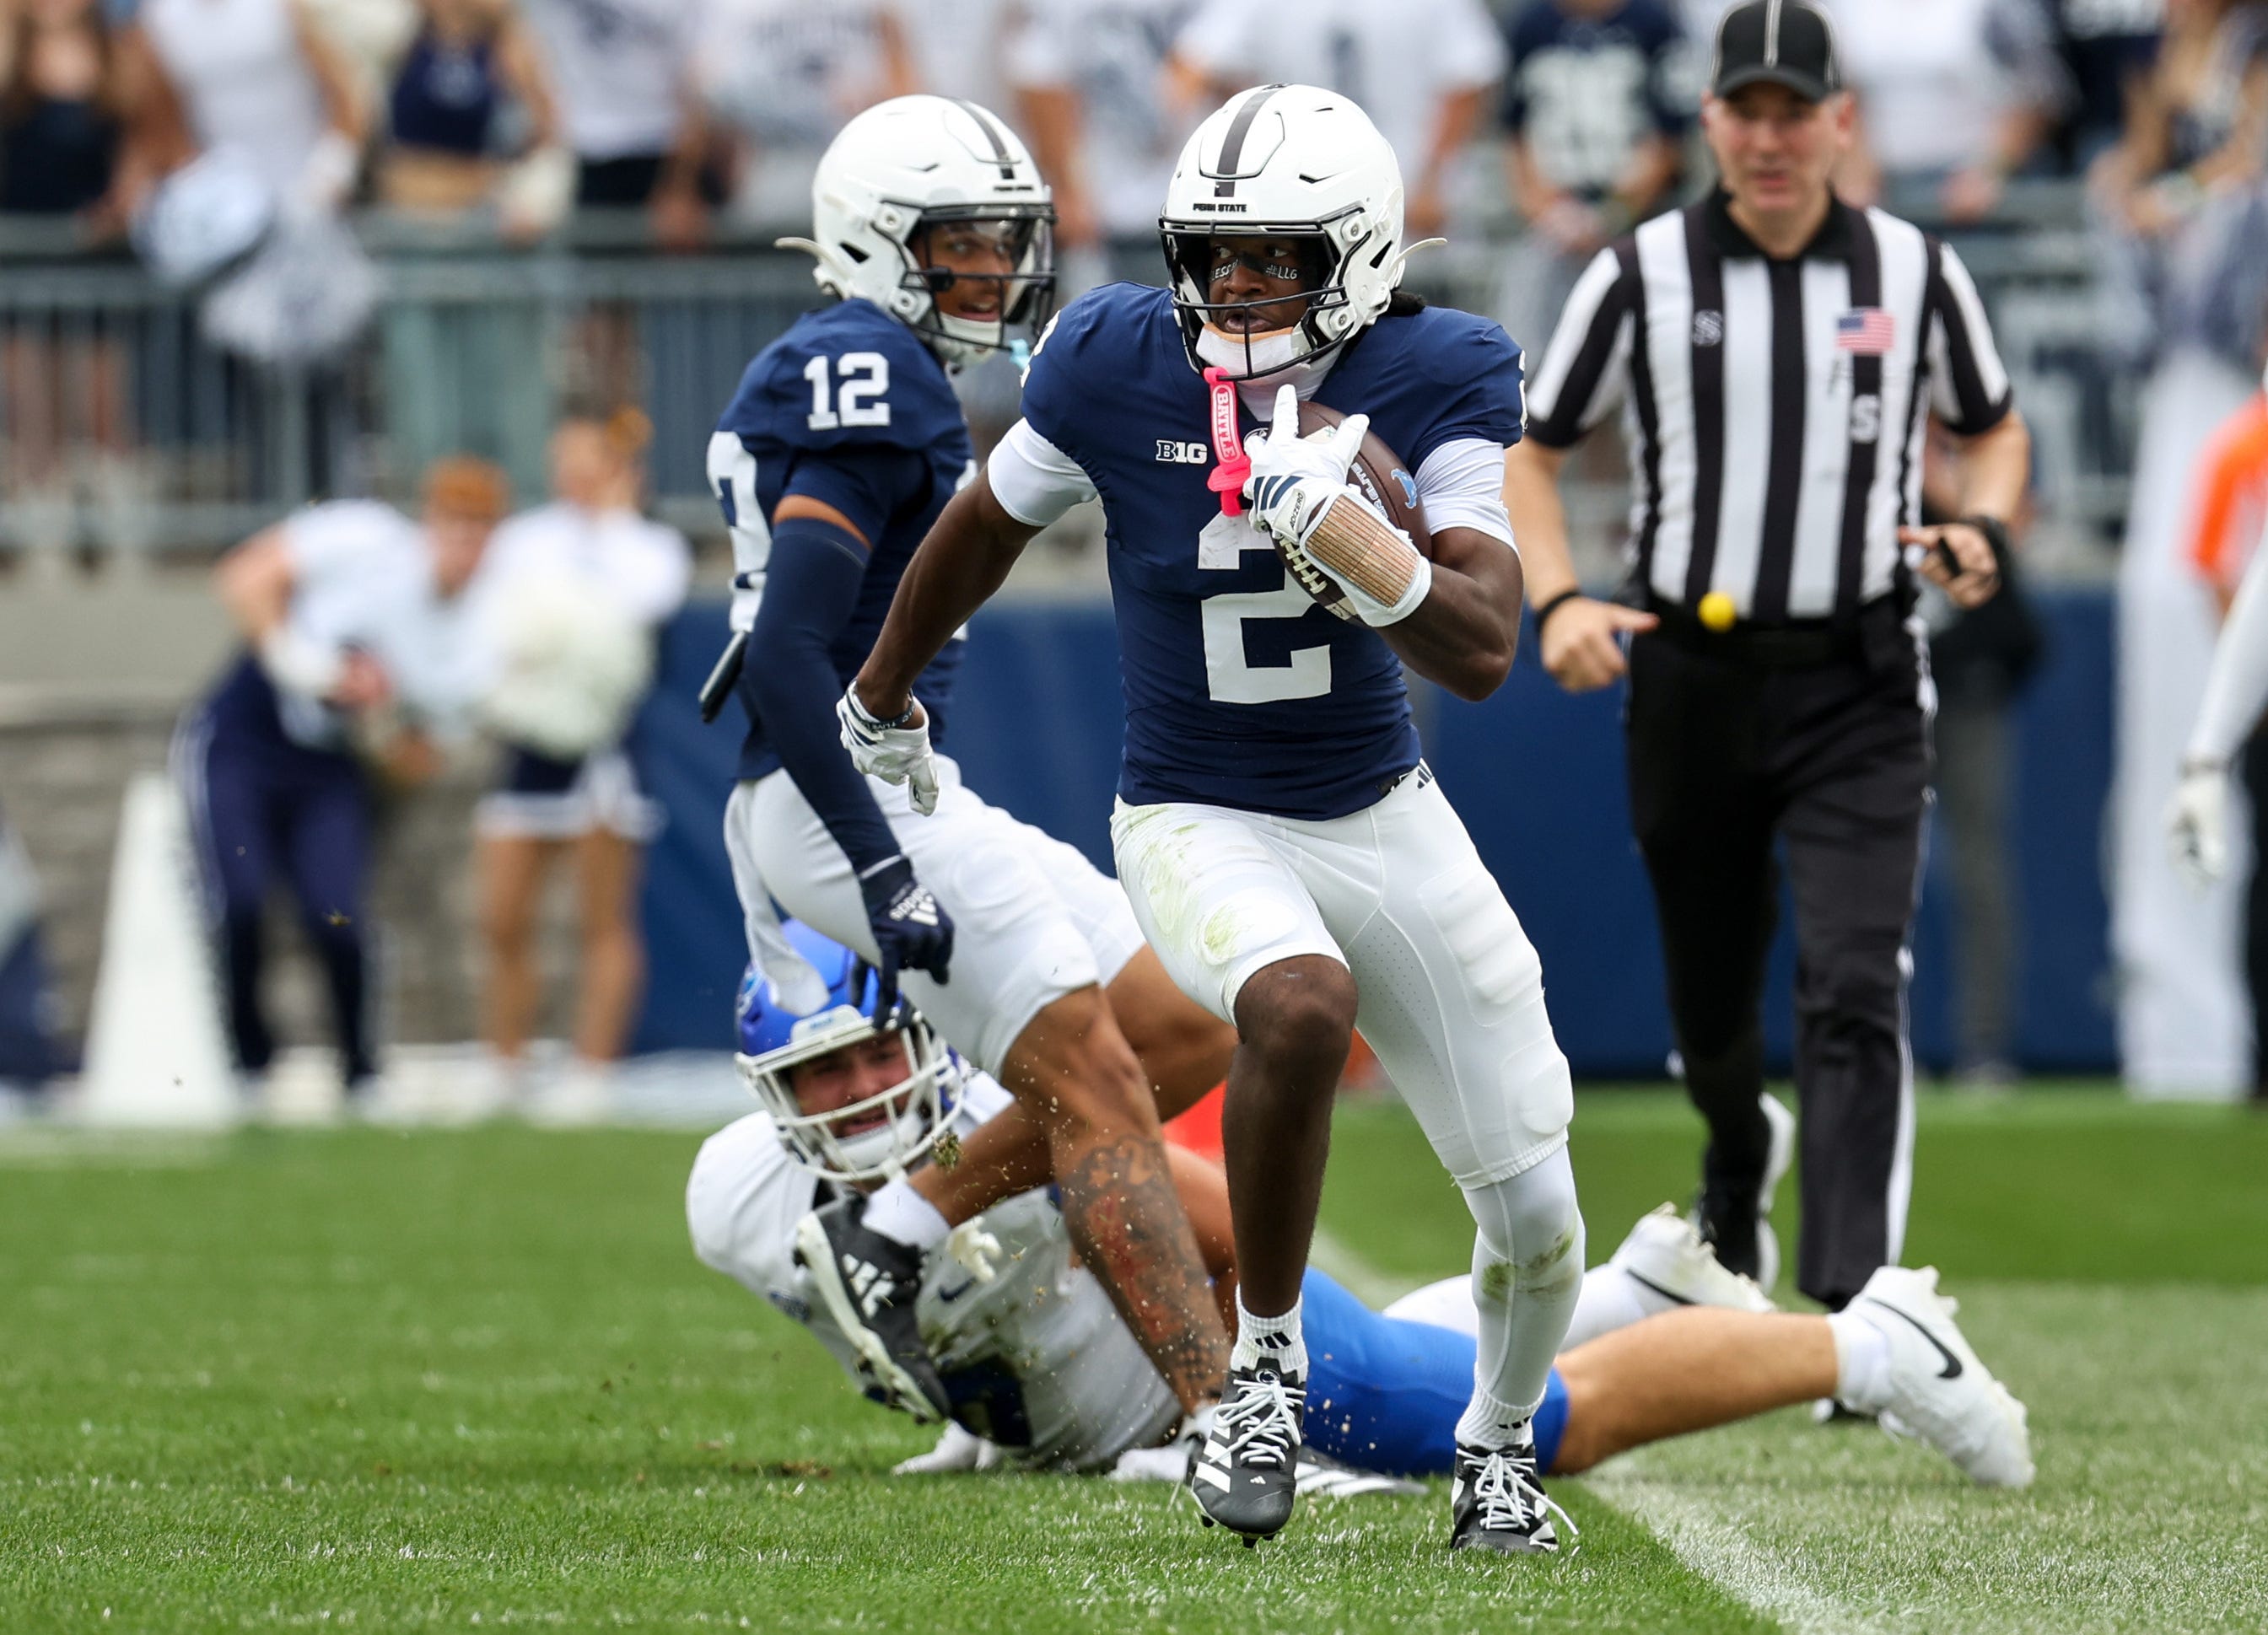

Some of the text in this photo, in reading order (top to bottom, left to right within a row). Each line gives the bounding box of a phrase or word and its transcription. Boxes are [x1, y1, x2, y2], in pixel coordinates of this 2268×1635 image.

[1218, 204, 1247, 212] STATE
[804, 352, 892, 430] 12
[1217, 392, 1235, 458] BATTLE
[1350, 462, 1379, 500] ELITE
[1198, 508, 1332, 705] 2
